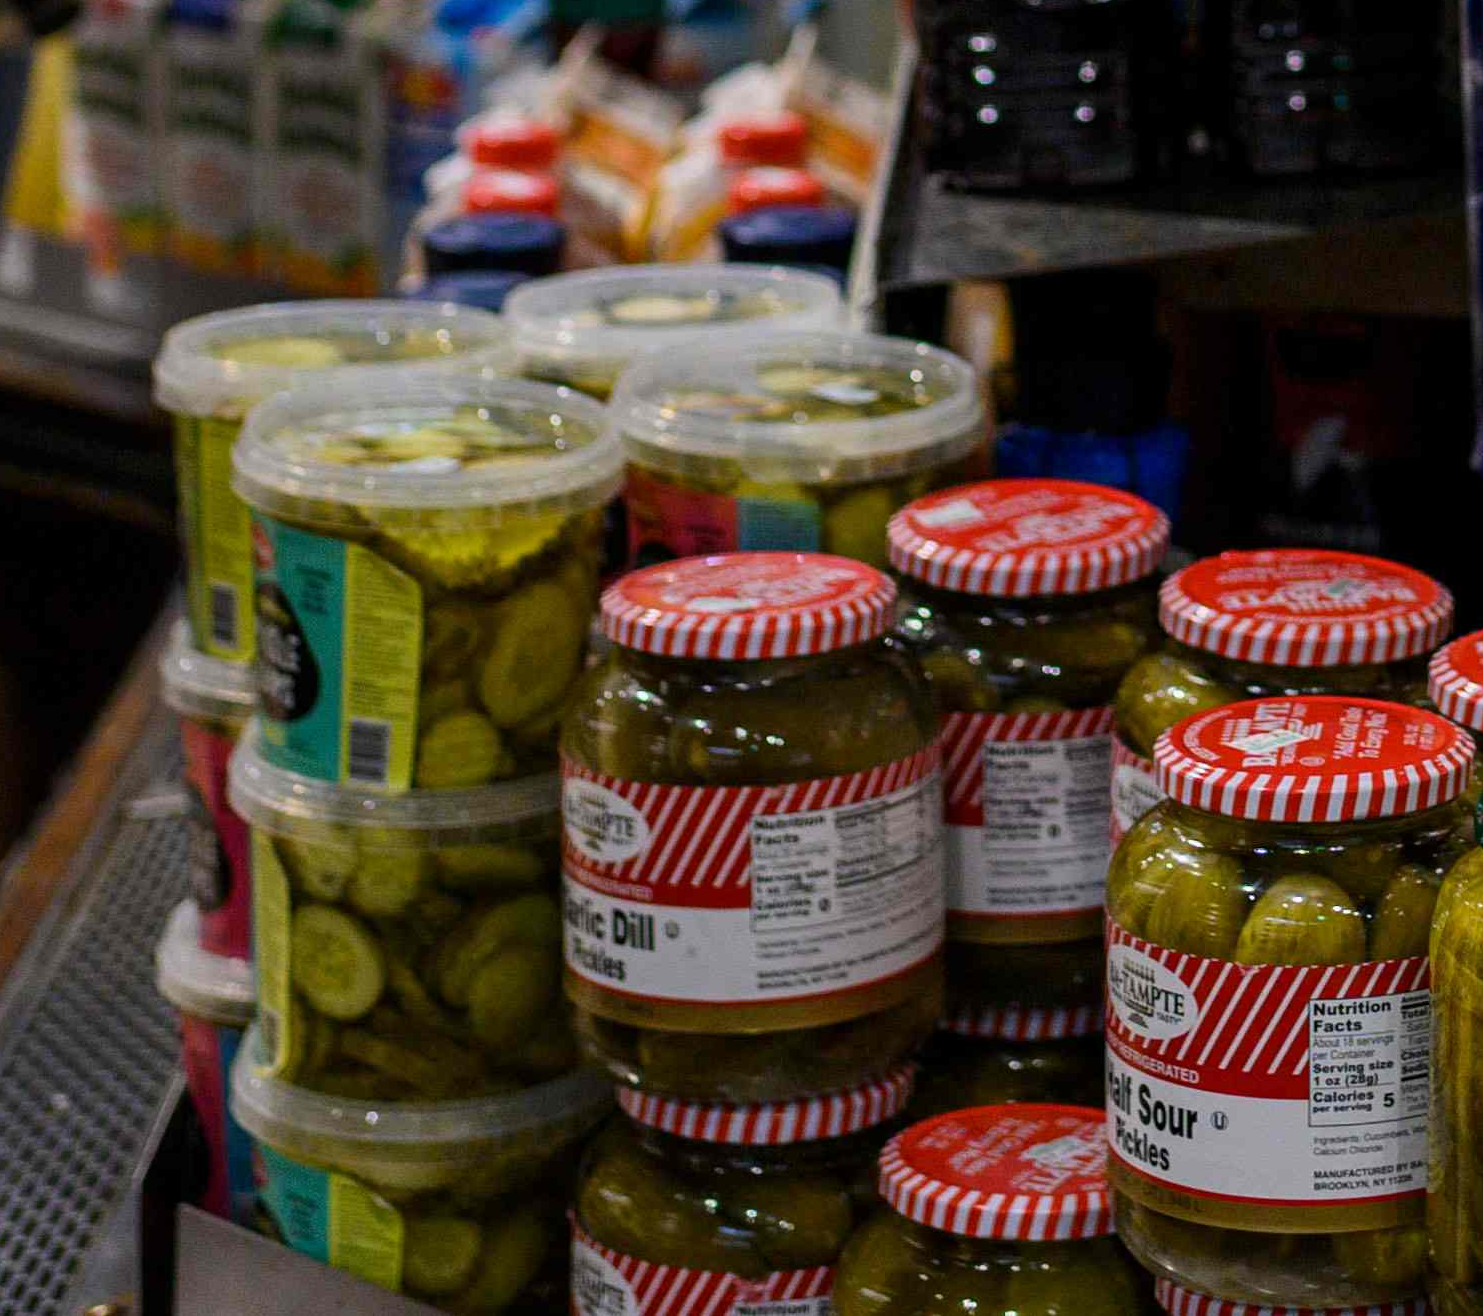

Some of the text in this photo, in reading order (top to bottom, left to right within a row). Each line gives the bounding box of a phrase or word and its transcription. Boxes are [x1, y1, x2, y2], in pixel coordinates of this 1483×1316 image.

[612, 907, 657, 952] Dill
[1312, 1000, 1392, 1017] Nutrition
[1313, 1018, 1364, 1034] Facts
[1138, 1082, 1199, 1140] Sour
[1312, 1089, 1395, 1108] Calories 5
[1115, 1118, 1171, 1171] Pickles
